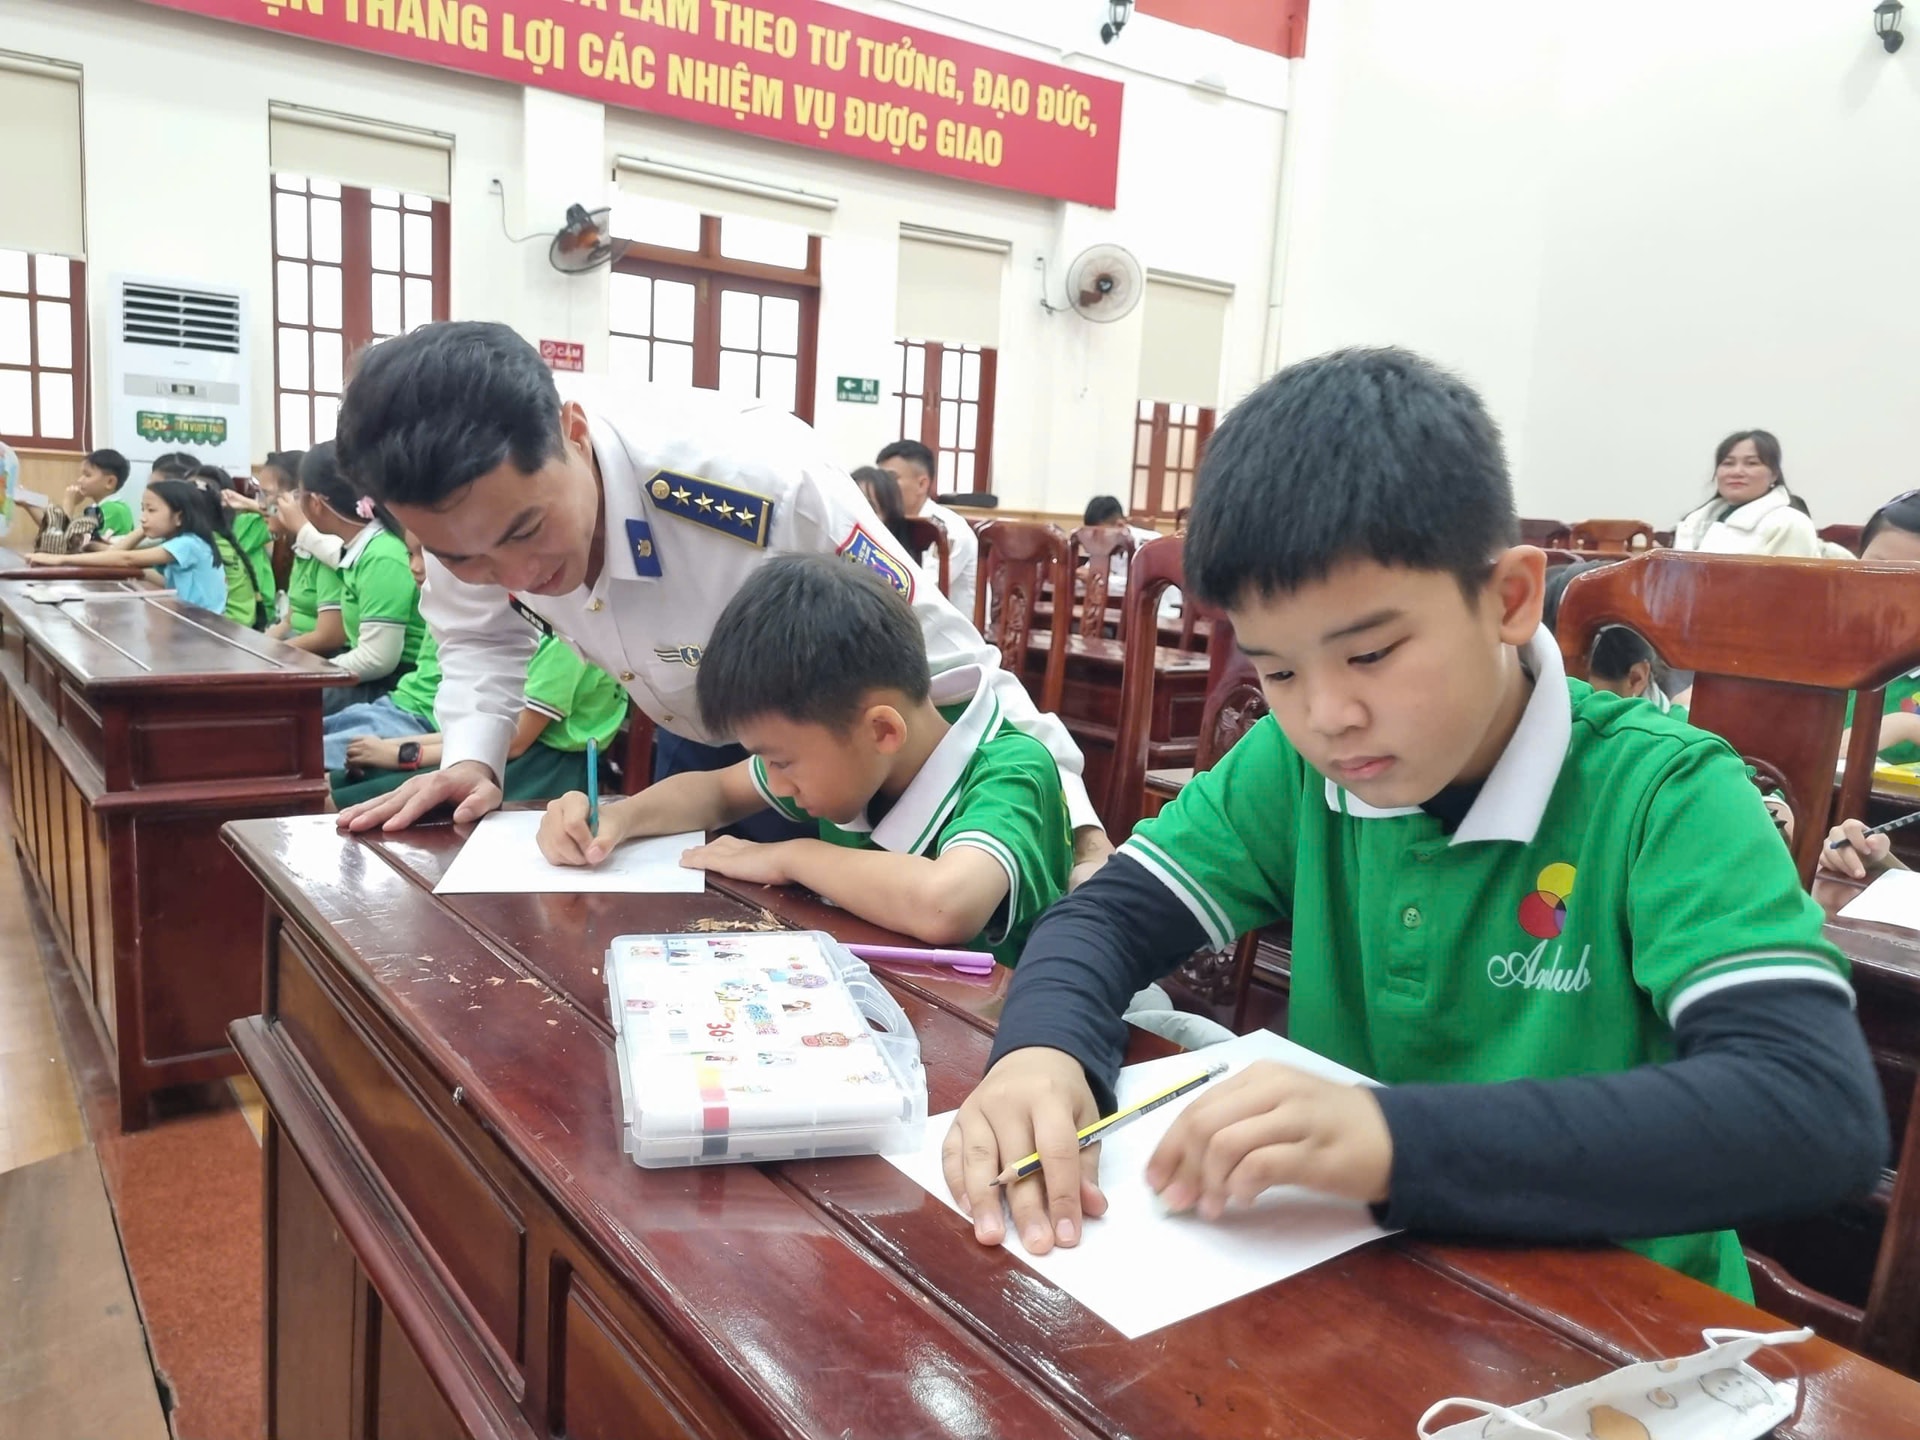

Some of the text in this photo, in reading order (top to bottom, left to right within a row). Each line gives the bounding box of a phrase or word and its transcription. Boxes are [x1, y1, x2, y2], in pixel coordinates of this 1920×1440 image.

[502, 12, 565, 75] LỢI
[578, 31, 656, 89] CÁC
[667, 52, 784, 120] NHIỆM
[793, 84, 836, 139] VỤ
[844, 97, 928, 155] ĐƯỢC
[936, 118, 1003, 167] GIAO
[711, 0, 797, 59] THEO
[807, 24, 852, 71] TƯ
[856, 36, 965, 105] TƯỞNG,
[973, 67, 1030, 119] ĐẠO
[1036, 83, 1098, 137] ĐỨC,
